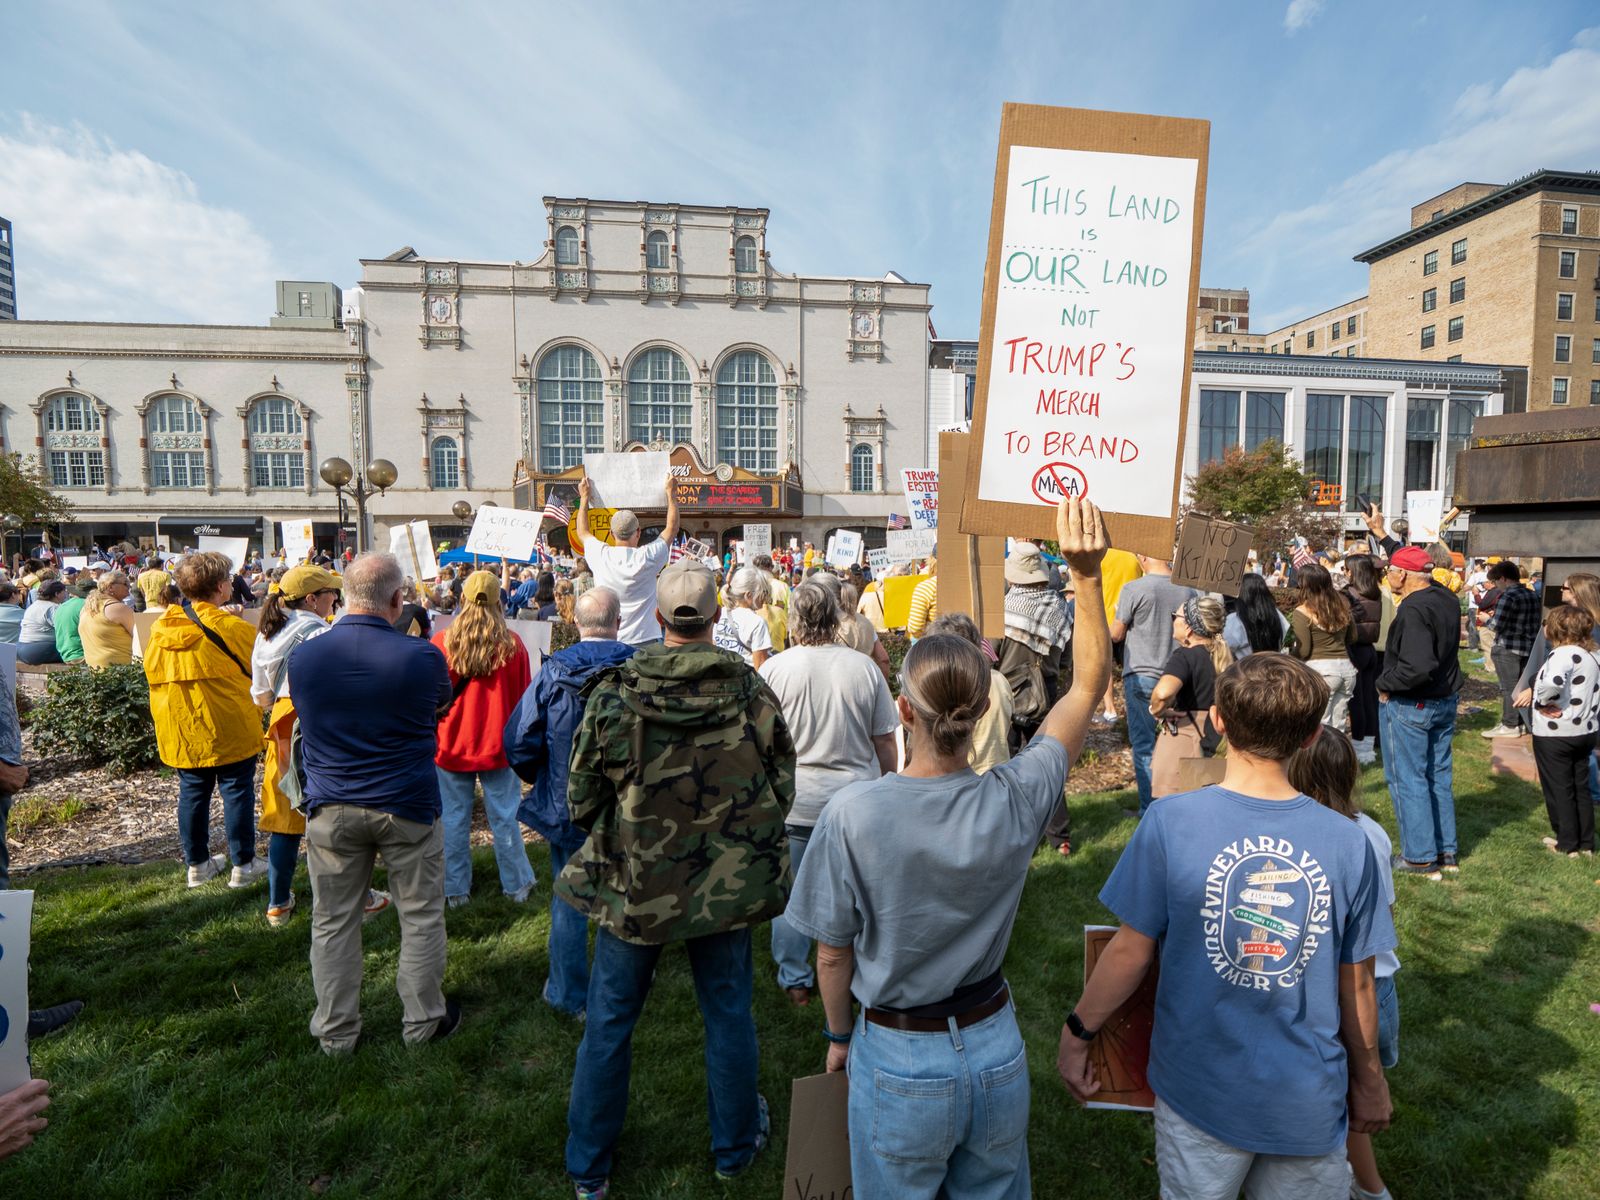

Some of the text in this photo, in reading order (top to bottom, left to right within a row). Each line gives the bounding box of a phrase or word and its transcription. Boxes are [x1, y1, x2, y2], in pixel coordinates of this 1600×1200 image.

[1021, 175, 1180, 223] THIS LAND
[1081, 228, 1098, 242] IS
[1005, 251, 1168, 290] OUR LAND
[1061, 303, 1100, 329] NOT
[1004, 336, 1136, 381] TRUMP'S
[1036, 389, 1101, 417] MERCH
[1004, 430, 1139, 464] TO BRAND
[905, 471, 936, 481] TRUMP
[907, 482, 938, 492] EPSTEI
[1038, 474, 1080, 497] MAGA
[677, 486, 701, 495] NDAY
[914, 510, 935, 520] DEEP
[927, 519, 938, 528] ST
[747, 525, 768, 534] FREE
[1203, 520, 1237, 547] NO
[836, 549, 854, 557] KIND
[1204, 835, 1331, 923] VINEYARD VINES
[1250, 892, 1282, 902] FISHING
[1203, 919, 1319, 992] SUMMER CAMP
